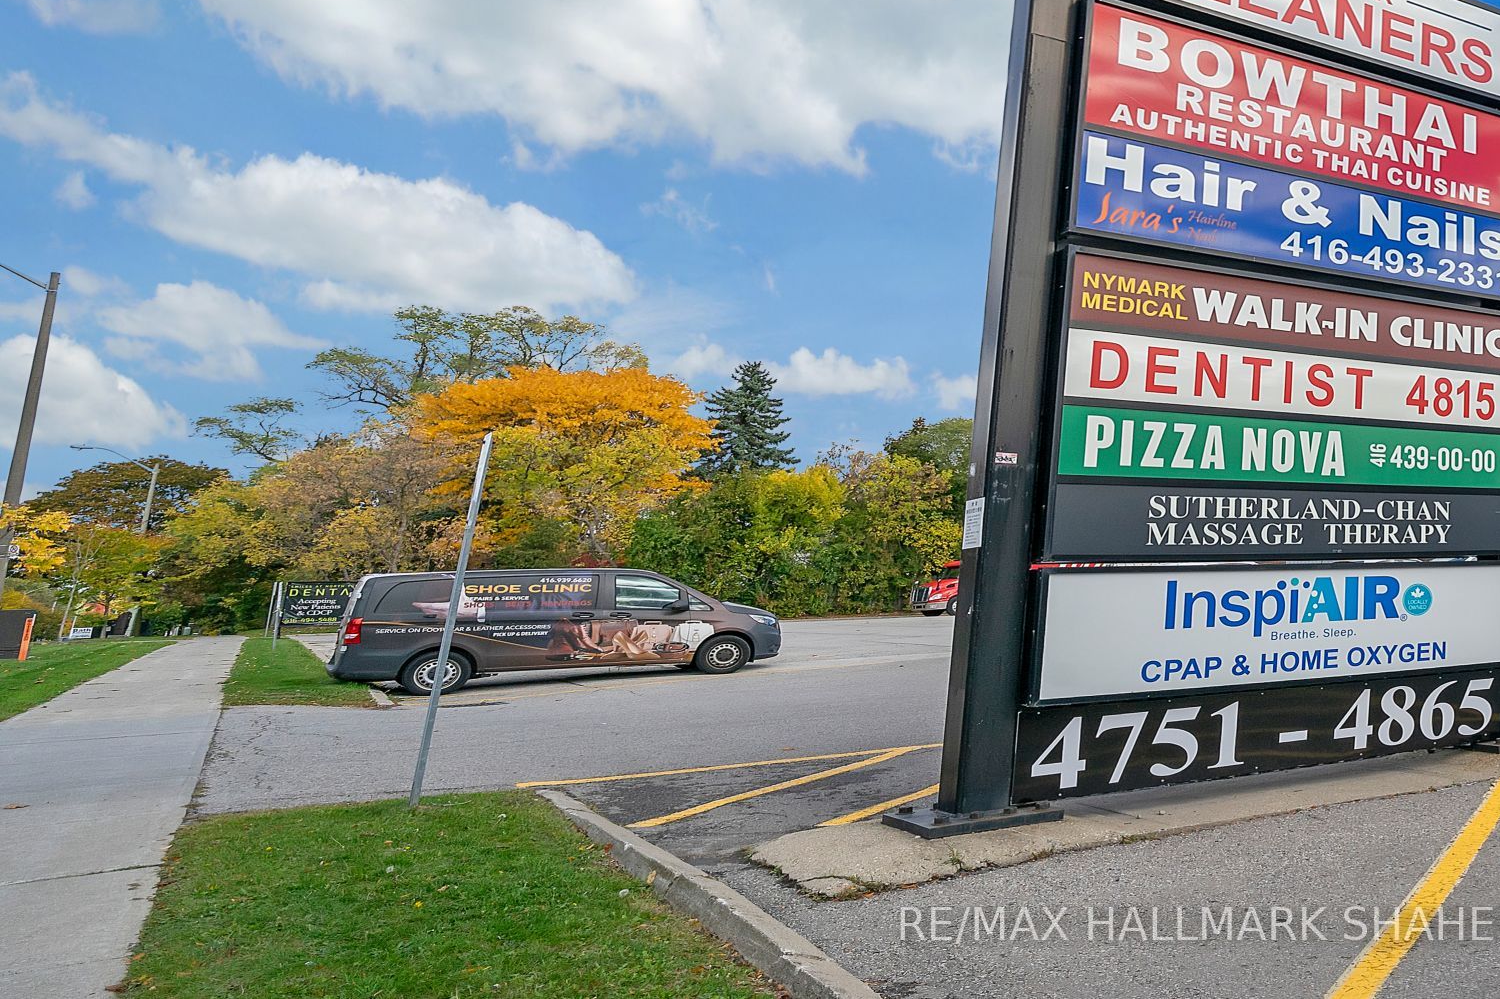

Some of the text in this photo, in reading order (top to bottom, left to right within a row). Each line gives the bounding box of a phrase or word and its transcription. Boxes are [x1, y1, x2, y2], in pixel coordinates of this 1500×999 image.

[1118, 17, 1478, 154] BOWTHAI
[1110, 104, 1490, 207] AUTHENTIC THAI CUISINE
[1176, 84, 1448, 172] RESTAURANT
[1085, 137, 1257, 212] Hair
[1280, 180, 1332, 229] &
[1081, 292, 1188, 321] MEDICAL
[1082, 271, 1186, 301] NYMARK
[1192, 287, 1378, 342] WALK-IN
[1089, 340, 1496, 421] DENTIST 4815
[1083, 415, 1496, 477] PIZZA NOVA 416 439-00-00
[1146, 523, 1452, 546] MASSAGE THERAPY
[1147, 495, 1451, 521] SUTHERLAND-CHAN
[465, 584, 592, 594] SHOE CLINIC
[1141, 641, 1447, 683] CPAP & HOME OXYGEN
[1270, 628, 1356, 641] Breathe. Sleep.
[1030, 678, 1495, 789] 4751 - 4865
